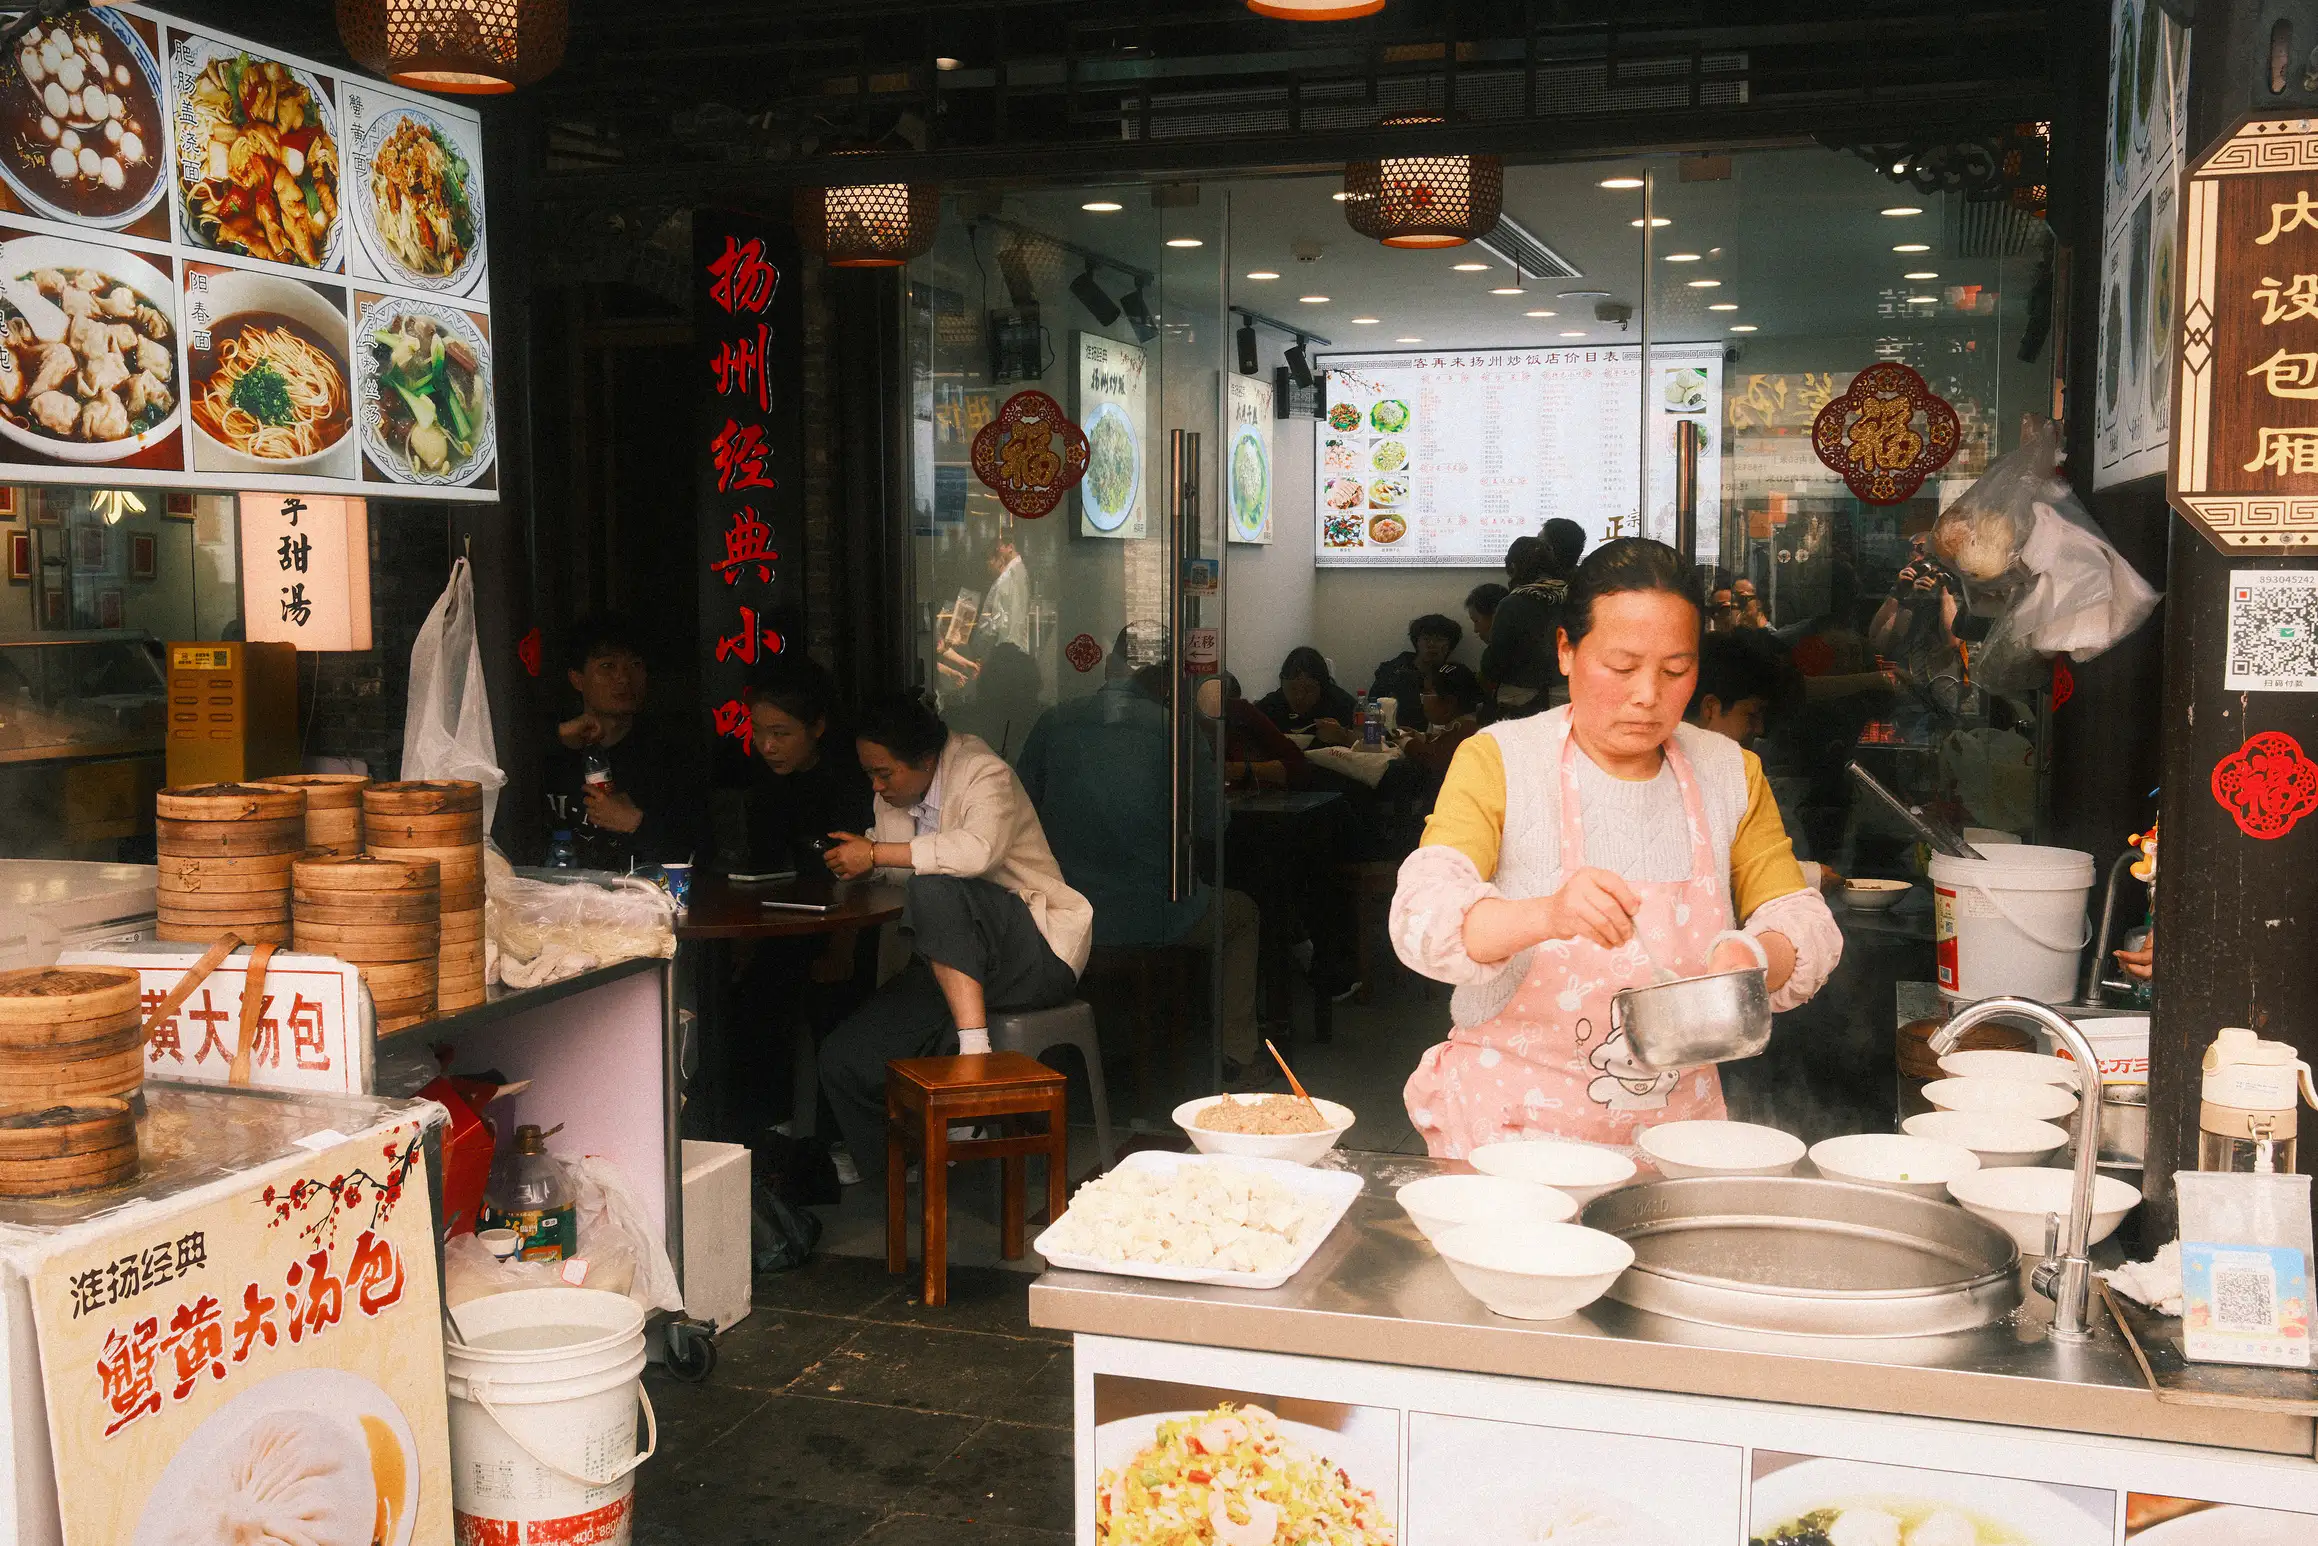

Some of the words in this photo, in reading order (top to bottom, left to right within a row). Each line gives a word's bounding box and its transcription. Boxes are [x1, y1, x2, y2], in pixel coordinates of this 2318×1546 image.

[174, 40, 201, 183] 肥肠盖浇面
[349, 93, 367, 174] 蟹黄面
[189, 270, 212, 351] 阳春面
[2244, 190, 2318, 477] 内设包厢
[360, 302, 382, 425] 鸭血粉丝汤
[1413, 351, 1619, 369] 客再来扬州炒饭店价目表
[1000, 420, 1061, 489] 福
[1847, 396, 1924, 472] 福
[2259, 575, 2316, 584] 893045242
[1188, 634, 1215, 649] 左移
[2264, 679, 2304, 688] 扫码付款
[141, 989, 331, 1071] 黄大汤包
[70, 1231, 208, 1319] 淮扬经典
[96, 1230, 405, 1437] 蟹黄大汤包
